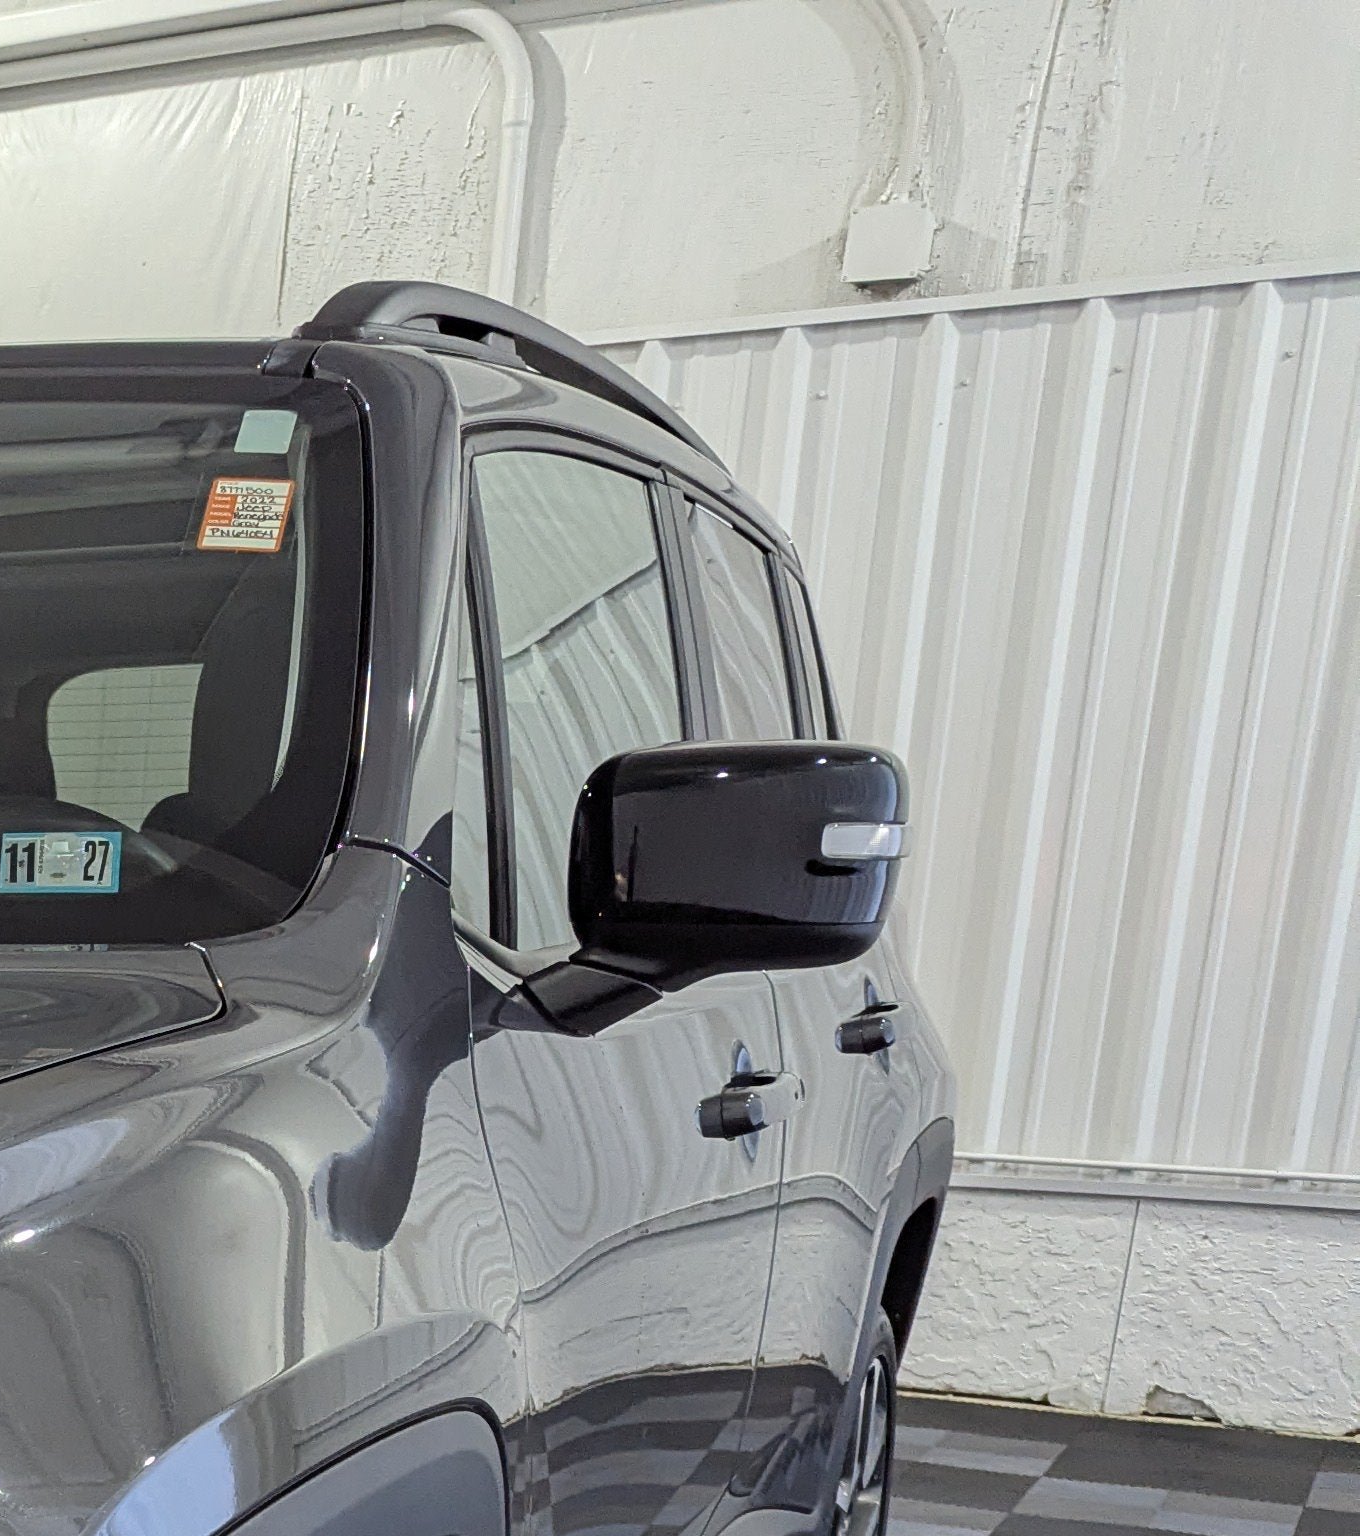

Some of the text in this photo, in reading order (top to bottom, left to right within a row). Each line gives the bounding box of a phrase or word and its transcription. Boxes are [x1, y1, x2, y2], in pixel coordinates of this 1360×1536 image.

[239, 495, 277, 504] 2022
[4, 842, 36, 884] 11
[83, 840, 110, 882] 27
